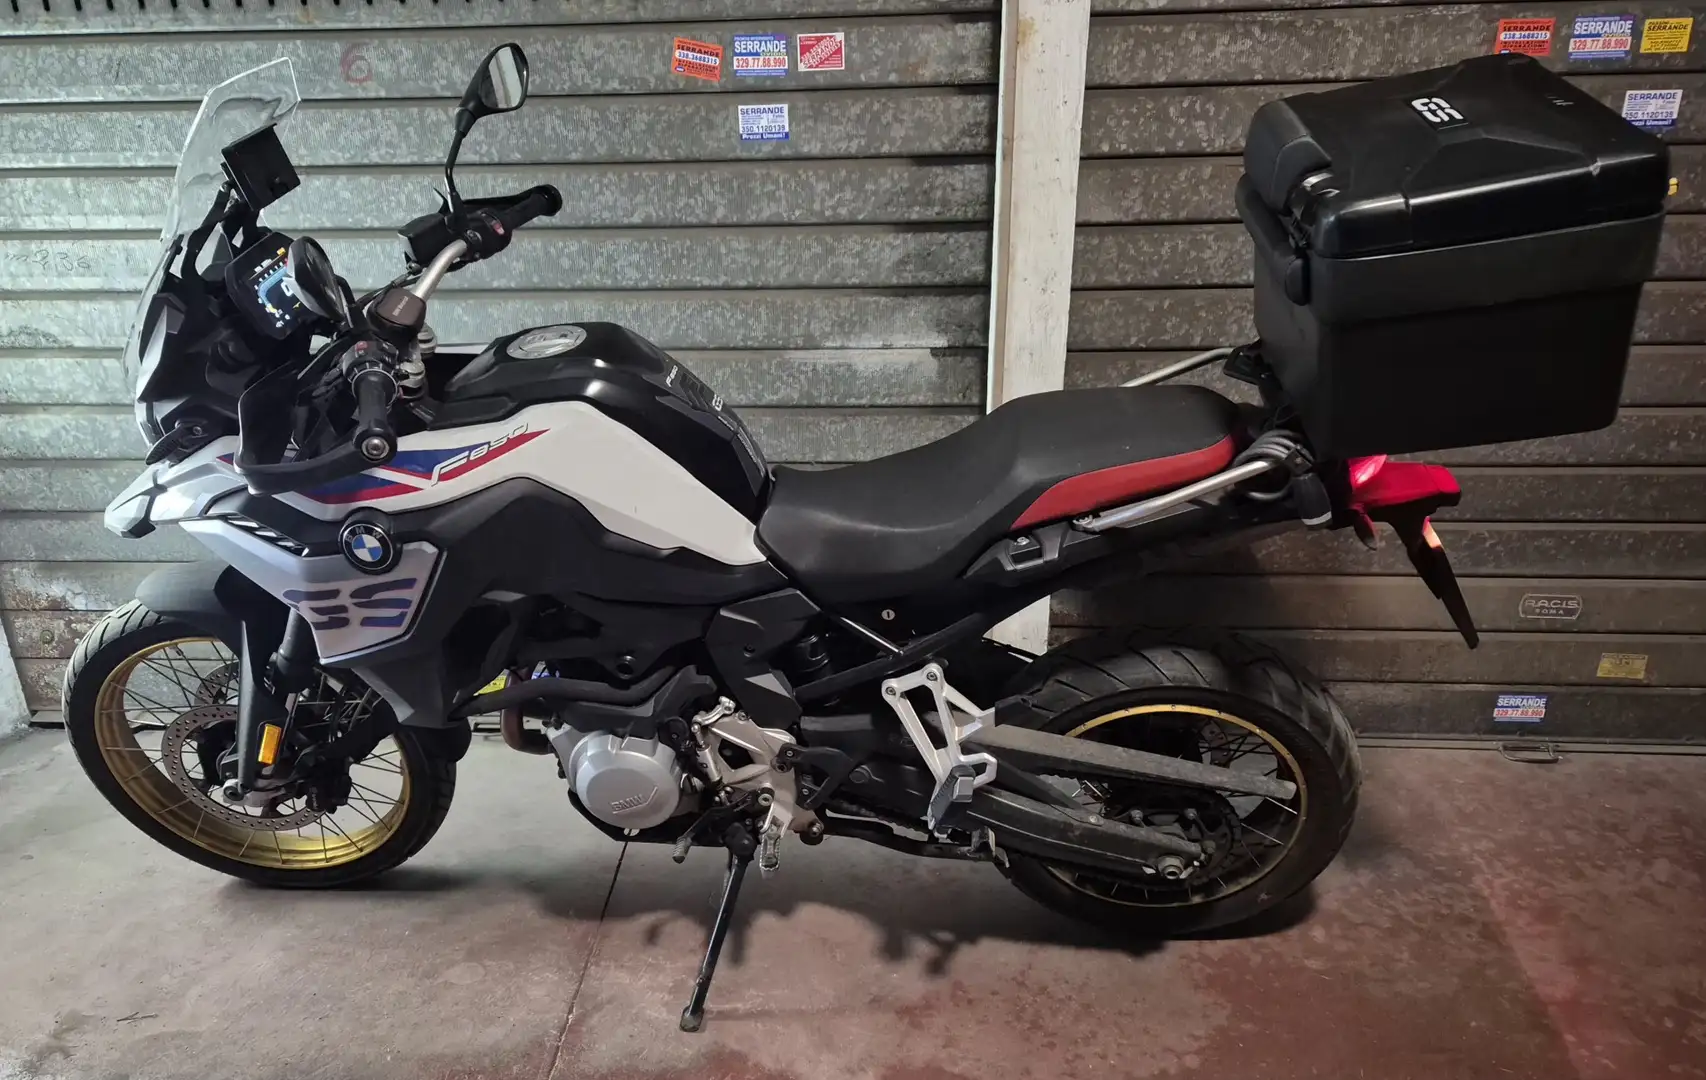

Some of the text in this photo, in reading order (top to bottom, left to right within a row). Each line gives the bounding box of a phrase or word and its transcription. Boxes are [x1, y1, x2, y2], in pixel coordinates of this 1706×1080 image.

[1573, 20, 1633, 34] SERRANDE
[1503, 32, 1548, 40] 338.3688315
[677, 44, 720, 58] SERRANDE
[734, 40, 786, 53] SERRANDE
[1572, 39, 1628, 50] 329.77.88.990
[677, 51, 718, 65] 338.3688315
[735, 57, 786, 68] 329.77.88.990
[1627, 92, 1678, 101] SERRANDE
[740, 106, 785, 116] SERRANDE
[1411, 97, 1464, 123] GS
[741, 125, 786, 133] 350.1120139
[345, 525, 382, 543] BMW
[282, 577, 417, 631] GS
[1497, 698, 1547, 706] SERRANDE
[611, 793, 643, 811] BMW
